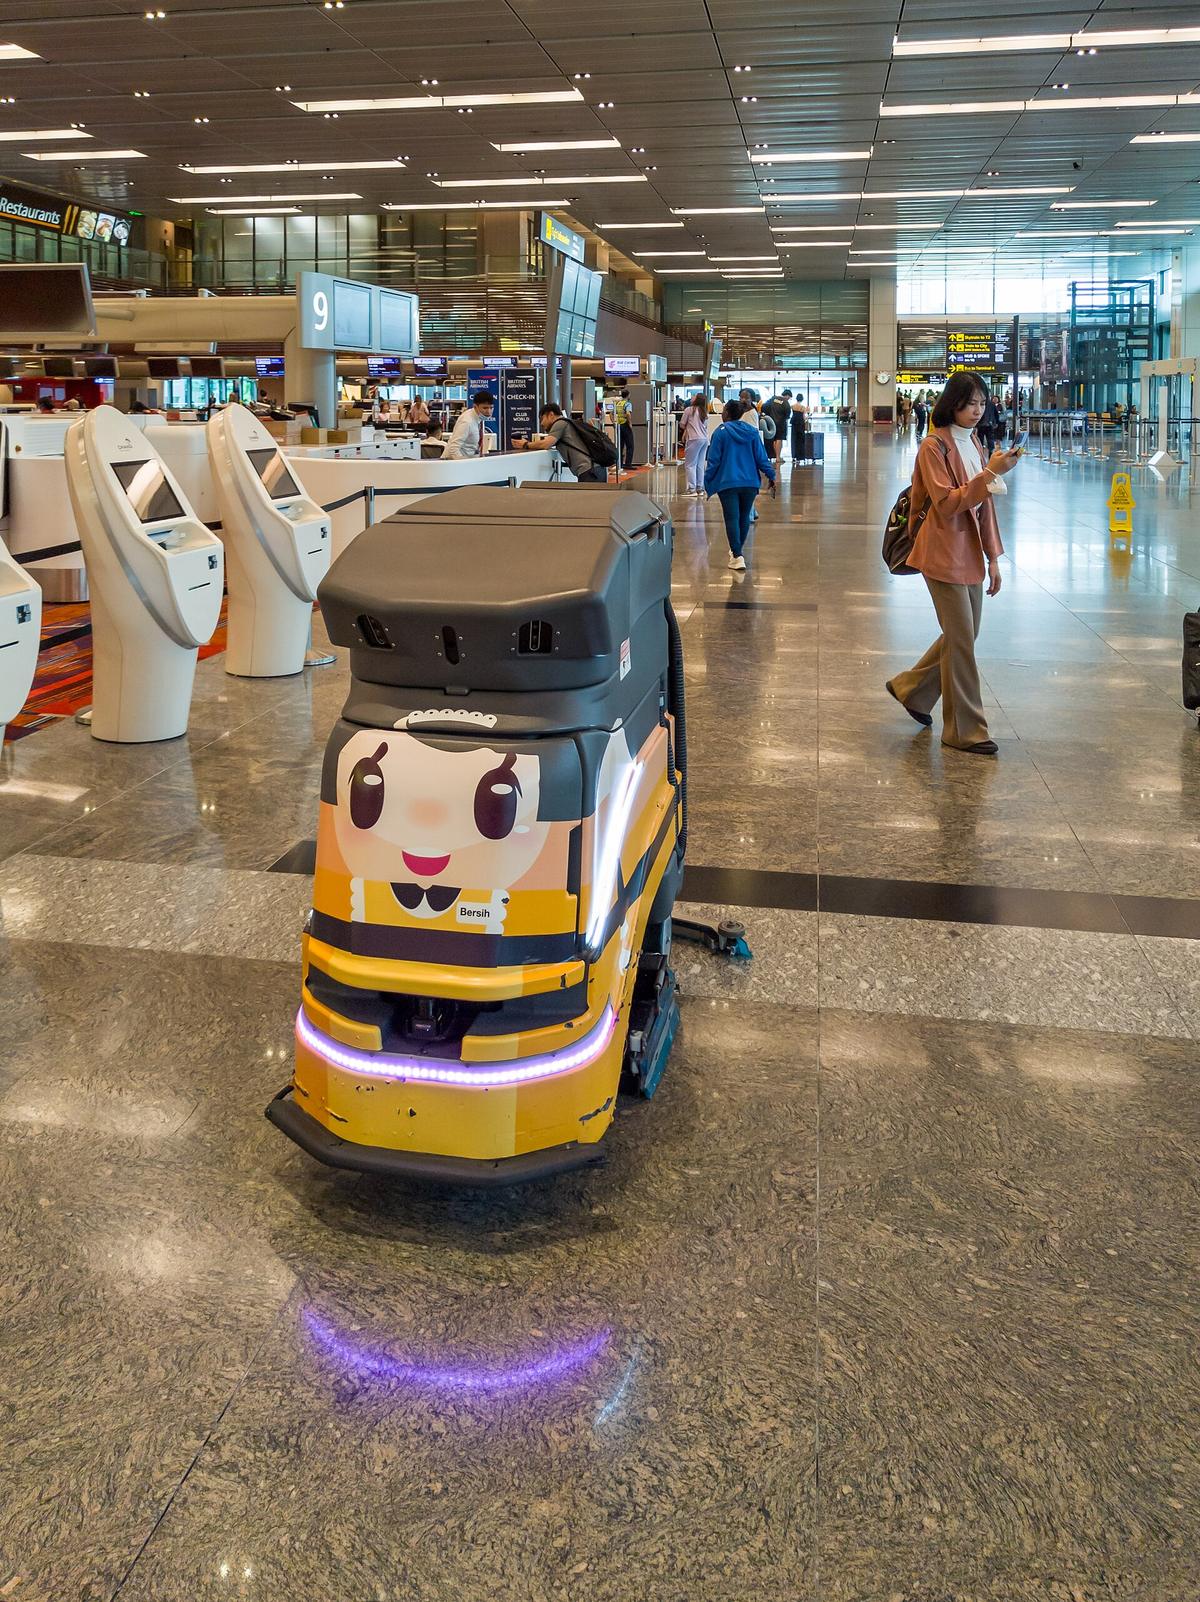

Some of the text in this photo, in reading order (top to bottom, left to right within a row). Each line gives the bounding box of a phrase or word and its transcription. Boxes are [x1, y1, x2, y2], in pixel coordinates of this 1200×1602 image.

[0, 197, 61, 224] Restaurants
[313, 291, 328, 331] 9
[460, 908, 490, 918] Bersih
